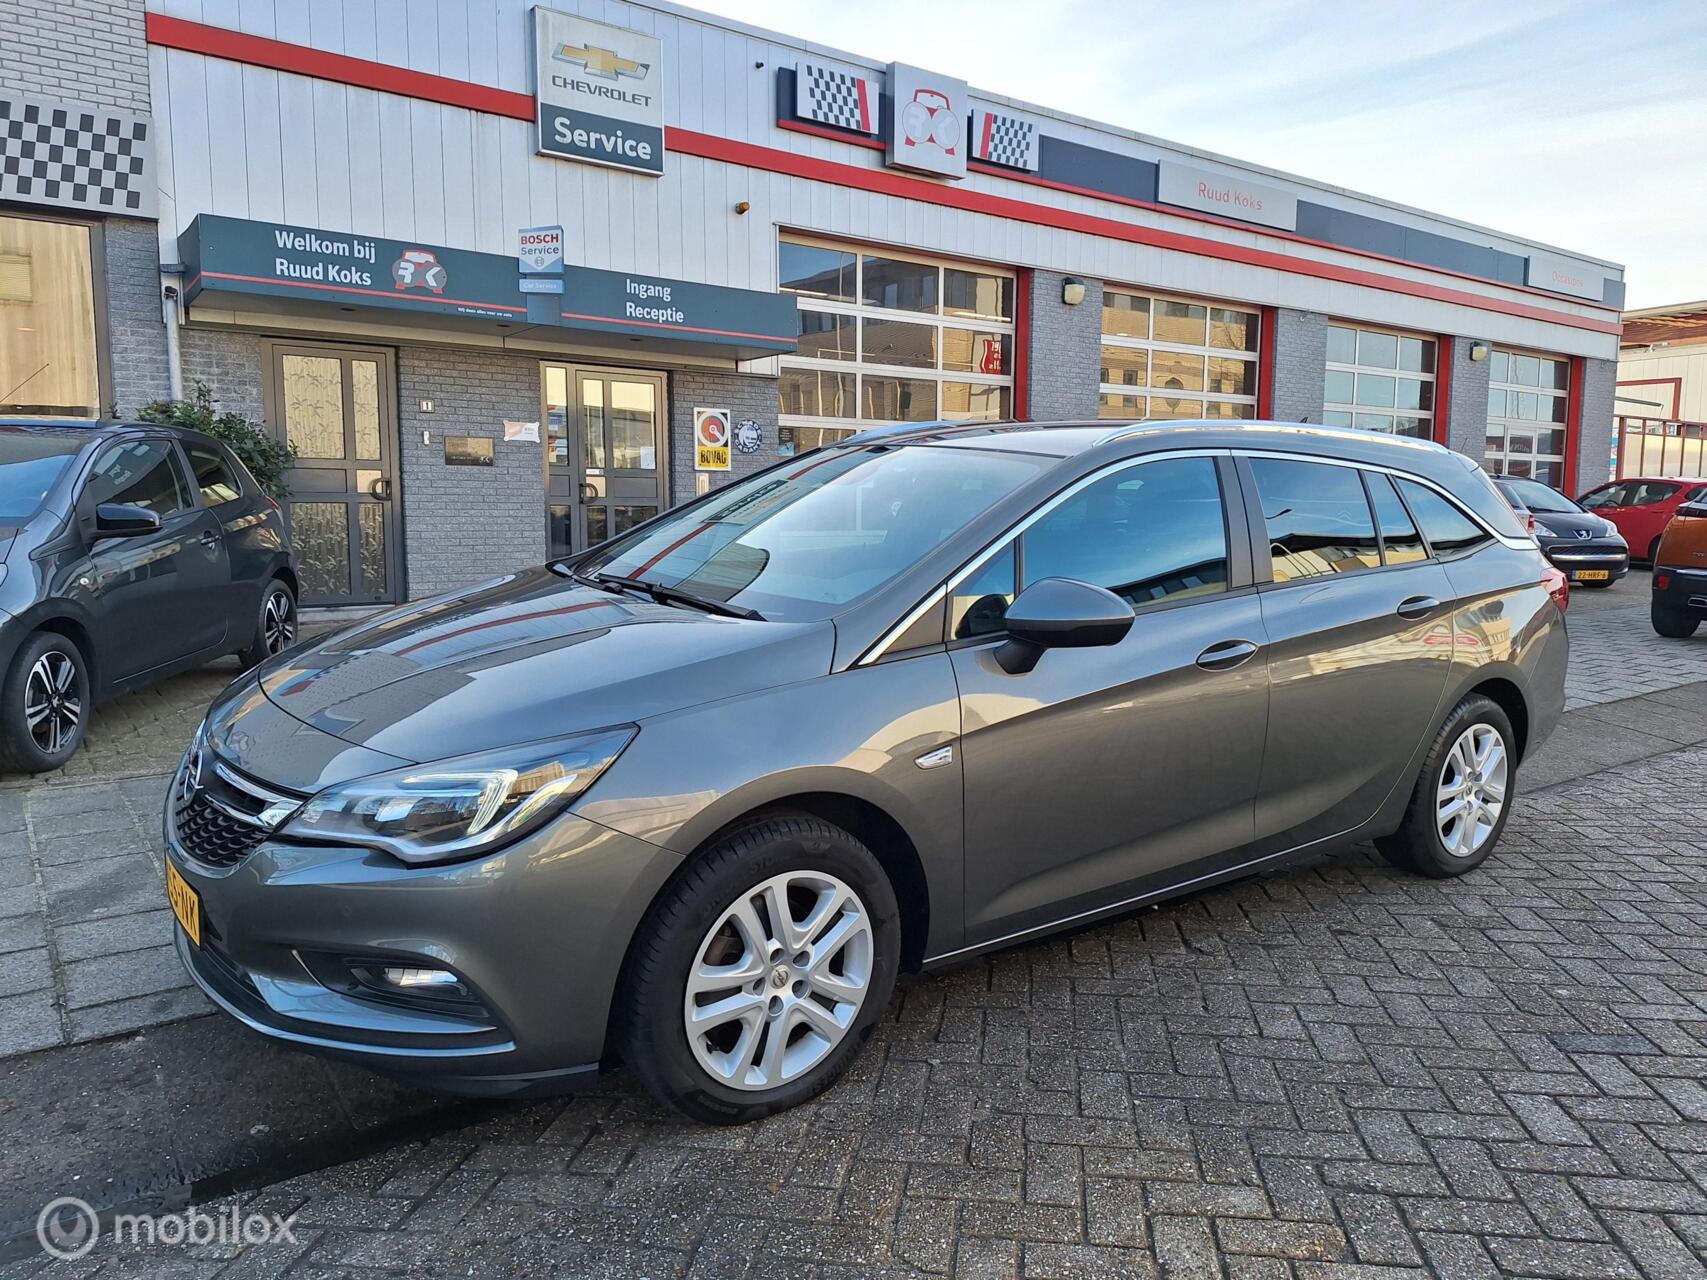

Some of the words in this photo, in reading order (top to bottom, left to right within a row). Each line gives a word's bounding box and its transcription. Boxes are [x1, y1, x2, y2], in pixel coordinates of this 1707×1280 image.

[551, 74, 652, 107] CHEVROLET
[553, 116, 652, 160] Service
[1198, 181, 1230, 203] Ruud
[1234, 190, 1263, 211] Koks
[274, 229, 350, 257] Welkom
[353, 239, 376, 264] bij
[520, 232, 560, 245] BOSCH
[520, 245, 560, 256] Service
[274, 257, 324, 281] Ruud
[327, 263, 372, 287] Koks
[626, 278, 672, 302] Ingang
[626, 301, 684, 324] Receptie
[700, 449, 727, 465] BOVAG
